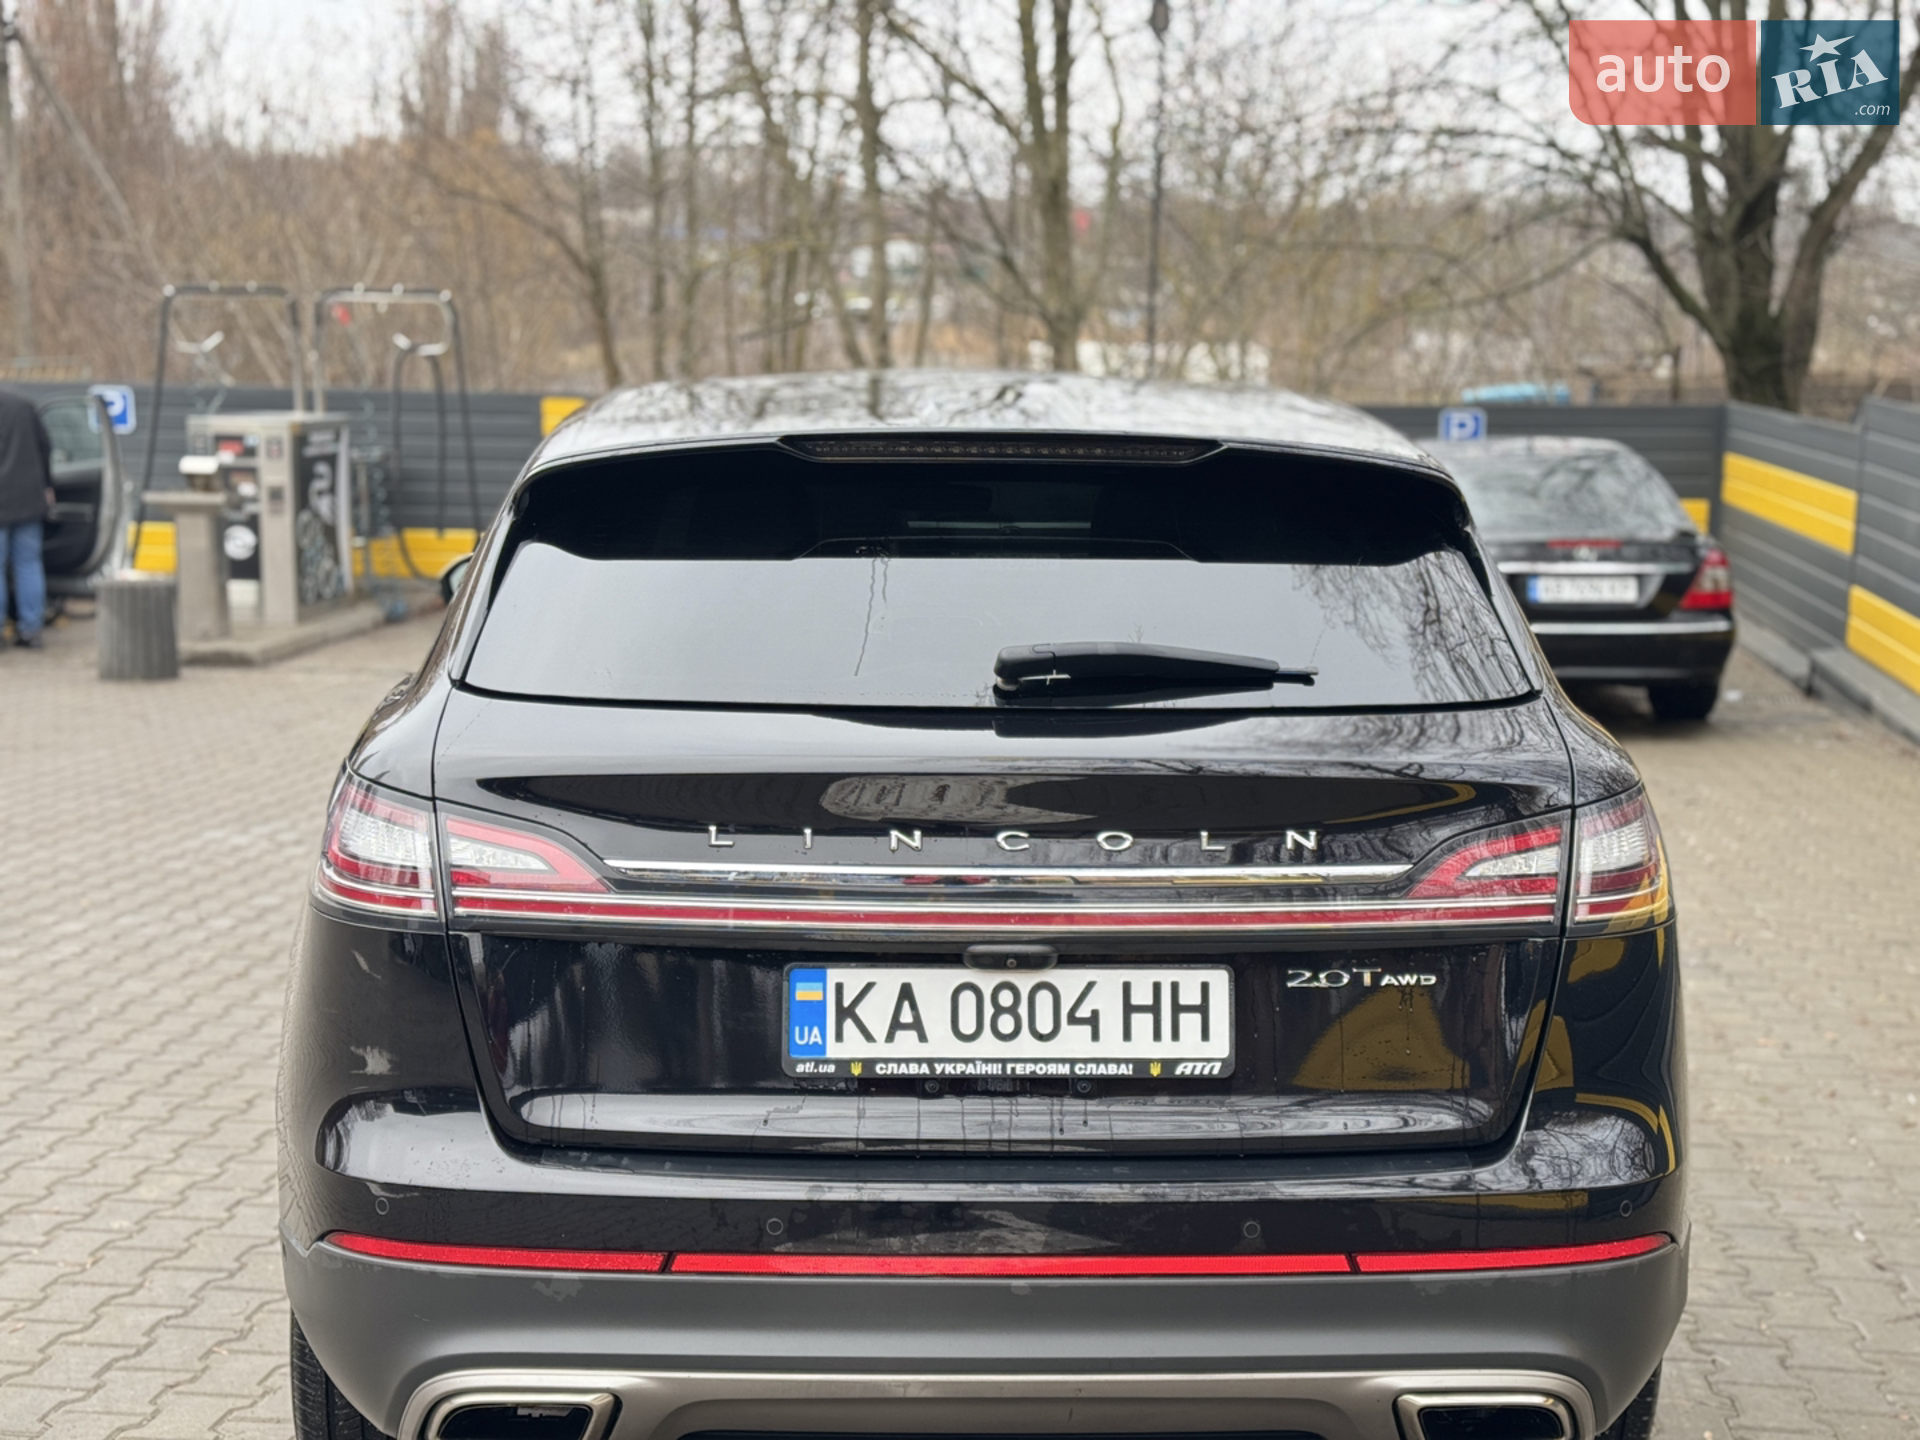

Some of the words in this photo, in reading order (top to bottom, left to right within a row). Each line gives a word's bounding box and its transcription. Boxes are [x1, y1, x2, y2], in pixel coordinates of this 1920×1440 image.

[707, 825, 1319, 851] LINCOLN
[833, 981, 929, 1044] KA
[950, 980, 1100, 1043] 0804
[1122, 980, 1211, 1042] HH
[795, 1026, 823, 1045] UA
[795, 1061, 836, 1074] atl.ua
[875, 1063, 930, 1075] СЛАВА
[1006, 1062, 1070, 1075] ГЕРОЯМ
[1074, 1062, 1133, 1075] СЛАВА!
